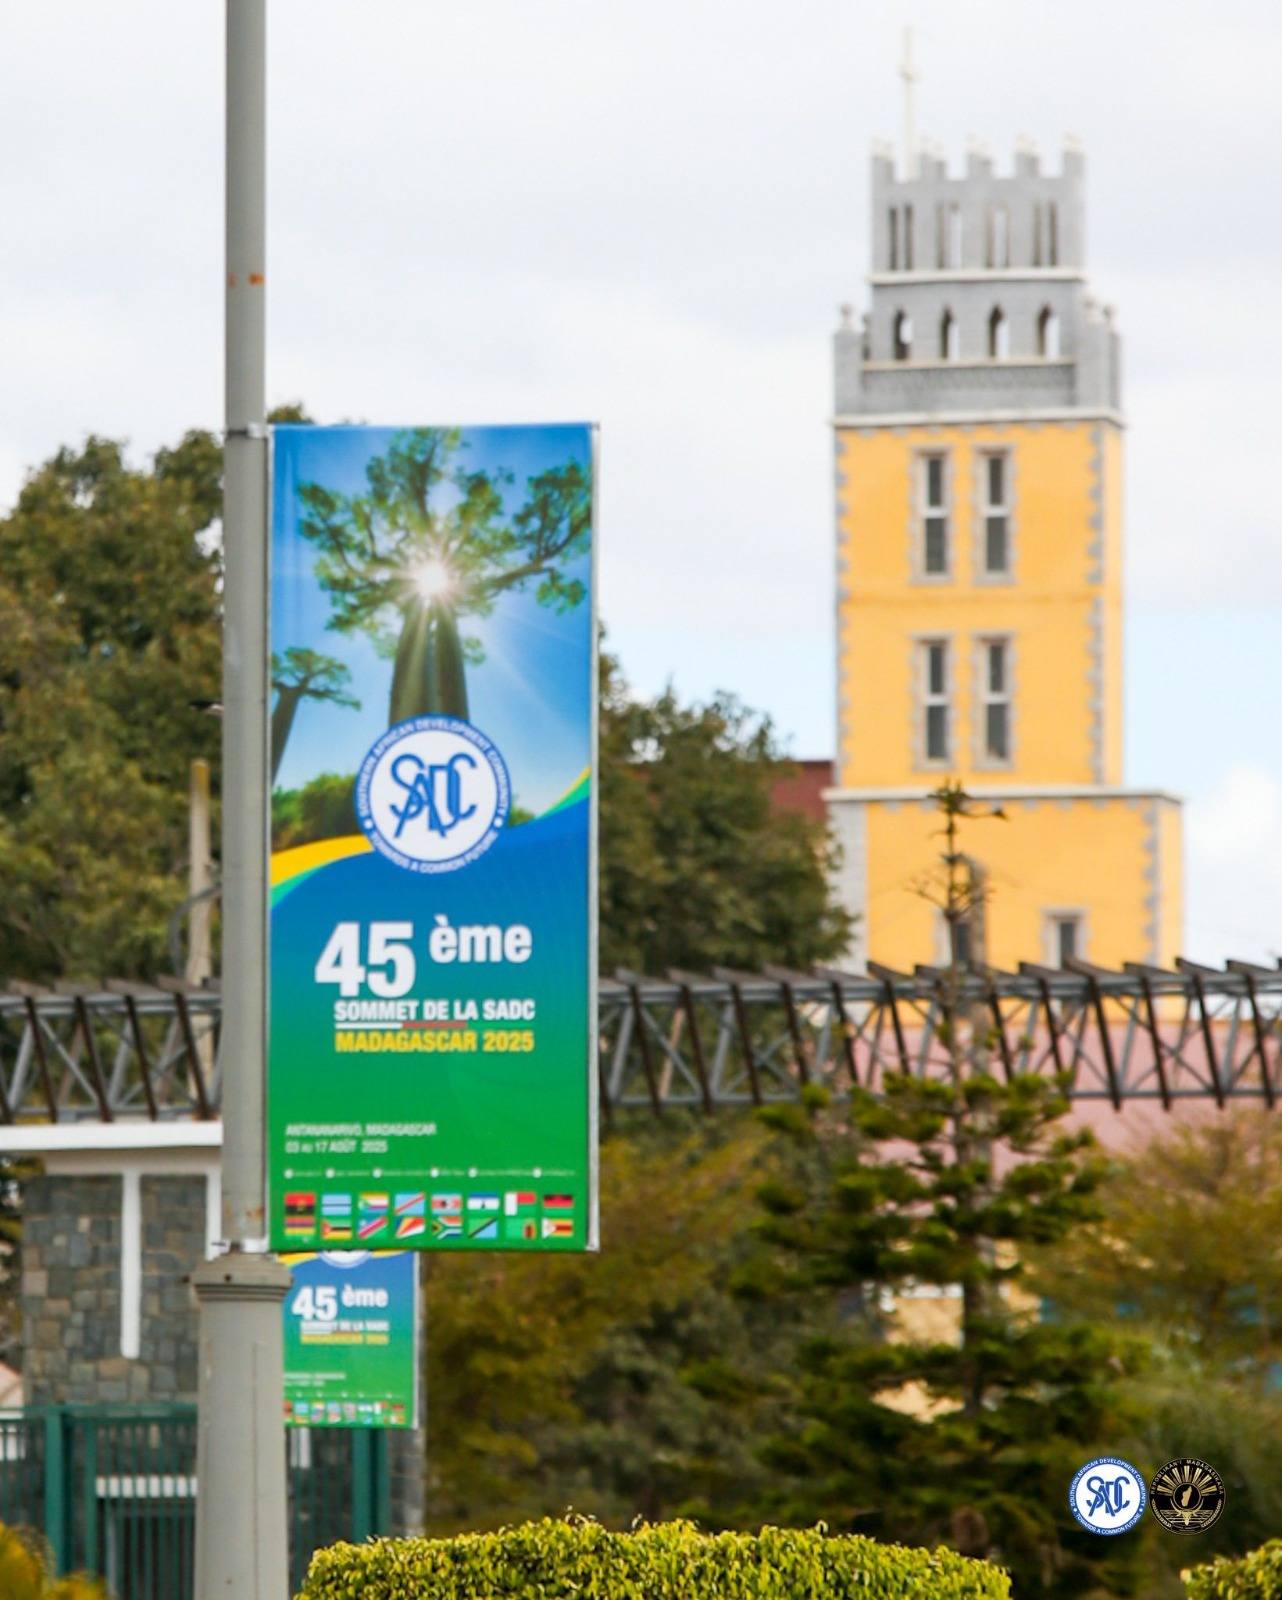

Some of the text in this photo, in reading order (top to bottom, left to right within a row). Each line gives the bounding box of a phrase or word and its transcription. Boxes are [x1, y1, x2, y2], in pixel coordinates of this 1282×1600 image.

[314, 914, 533, 998] 45 ème
[334, 999, 535, 1020] SOMMET DE LA SADC
[335, 1029, 535, 1053] MADAGASCAR 2025
[291, 1283, 389, 1321] 45 ème
